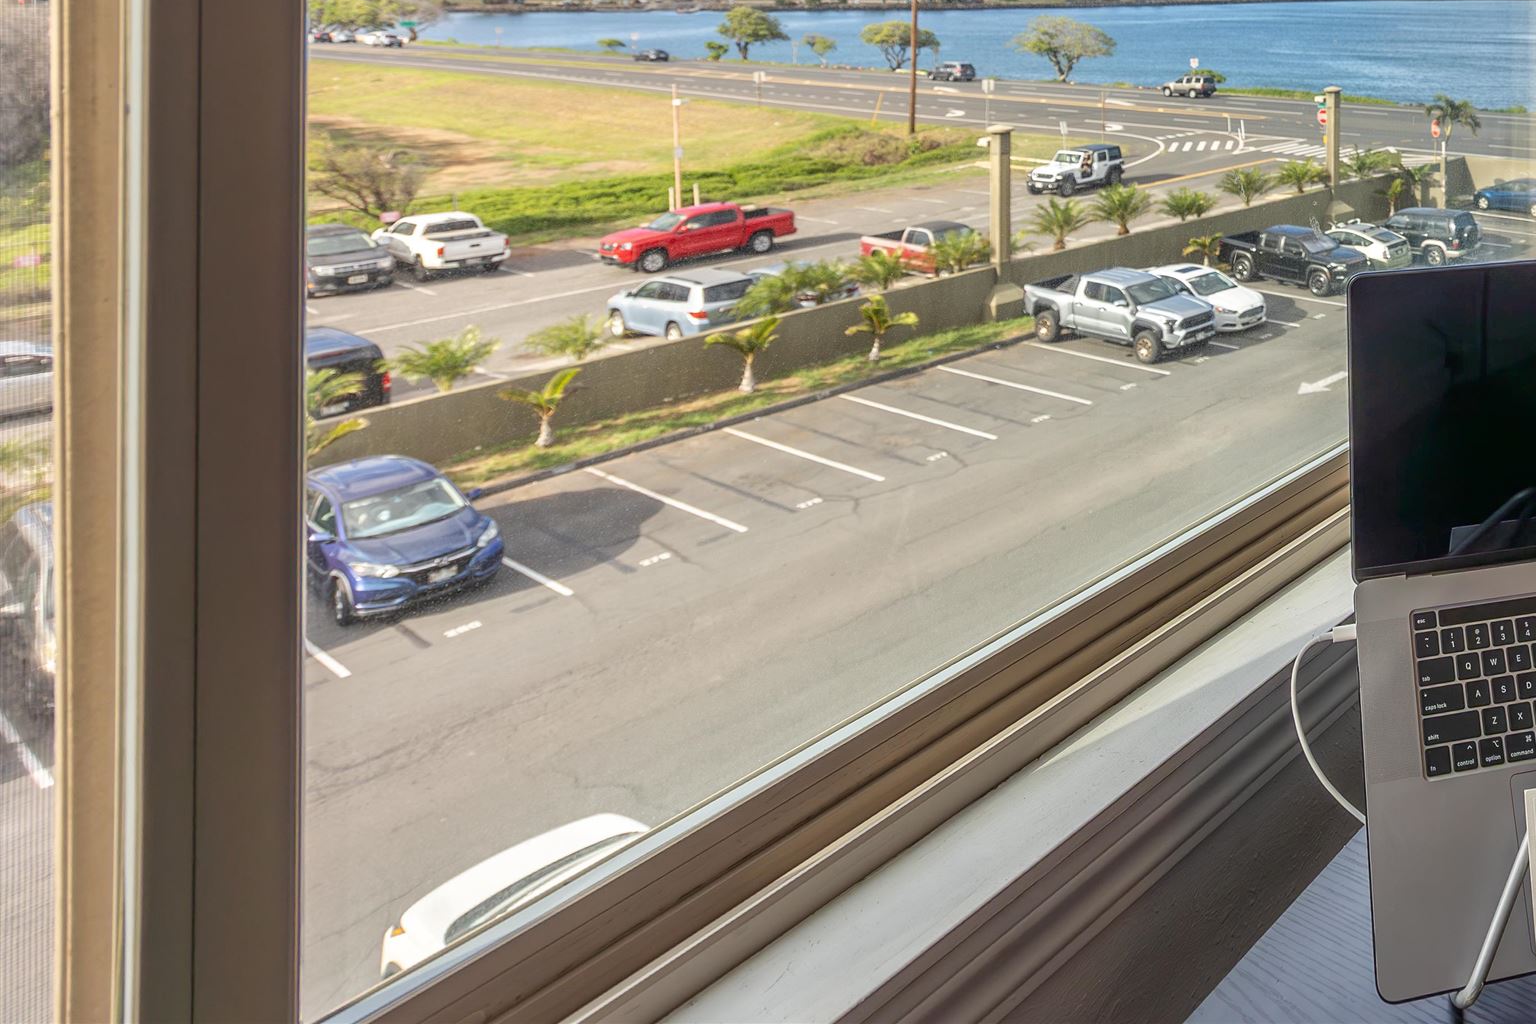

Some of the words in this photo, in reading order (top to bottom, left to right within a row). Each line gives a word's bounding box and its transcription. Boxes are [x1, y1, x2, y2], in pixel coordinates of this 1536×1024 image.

[1500, 633, 1506, 641] 3
[1525, 629, 1531, 637] 4
[1475, 637, 1481, 645] 2
[1489, 658, 1498, 666] W
[1516, 654, 1522, 662] E
[1465, 662, 1472, 670] Q
[1500, 685, 1507, 693] S
[1526, 681, 1532, 689] D
[1475, 689, 1481, 697] A
[1492, 716, 1498, 724] Z
[1517, 712, 1523, 720] X
[1510, 748, 1534, 758] command
[1456, 758, 1475, 767] control
